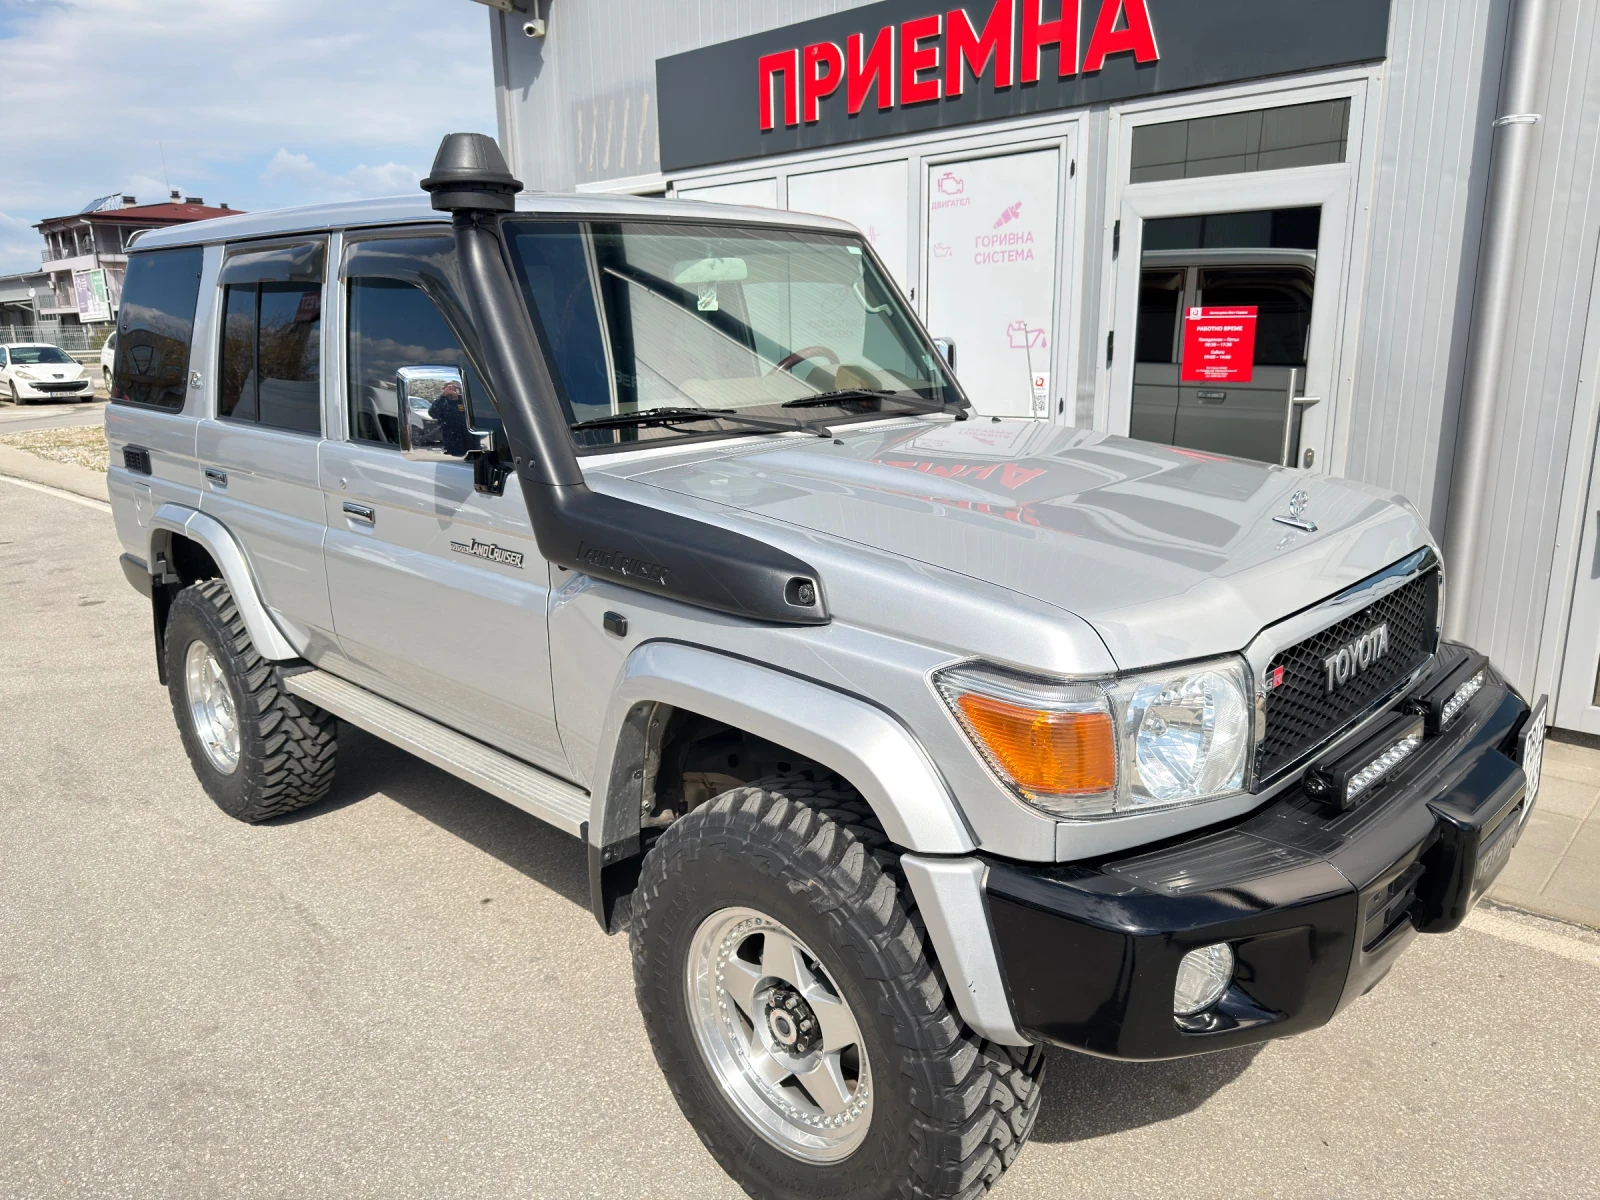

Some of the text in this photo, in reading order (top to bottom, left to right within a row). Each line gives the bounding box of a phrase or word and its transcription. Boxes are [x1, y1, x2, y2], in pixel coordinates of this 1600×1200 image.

[758, 0, 1160, 131] ПРИЕМНА
[931, 198, 971, 211] ДВИГАТЕЛ
[975, 231, 1034, 248] ГОРИВНА
[974, 248, 1034, 265] СИСТЕМА
[1325, 623, 1388, 692] TOYOTA
[1265, 668, 1284, 691] GR
[1478, 823, 1516, 880] TOYOTA
